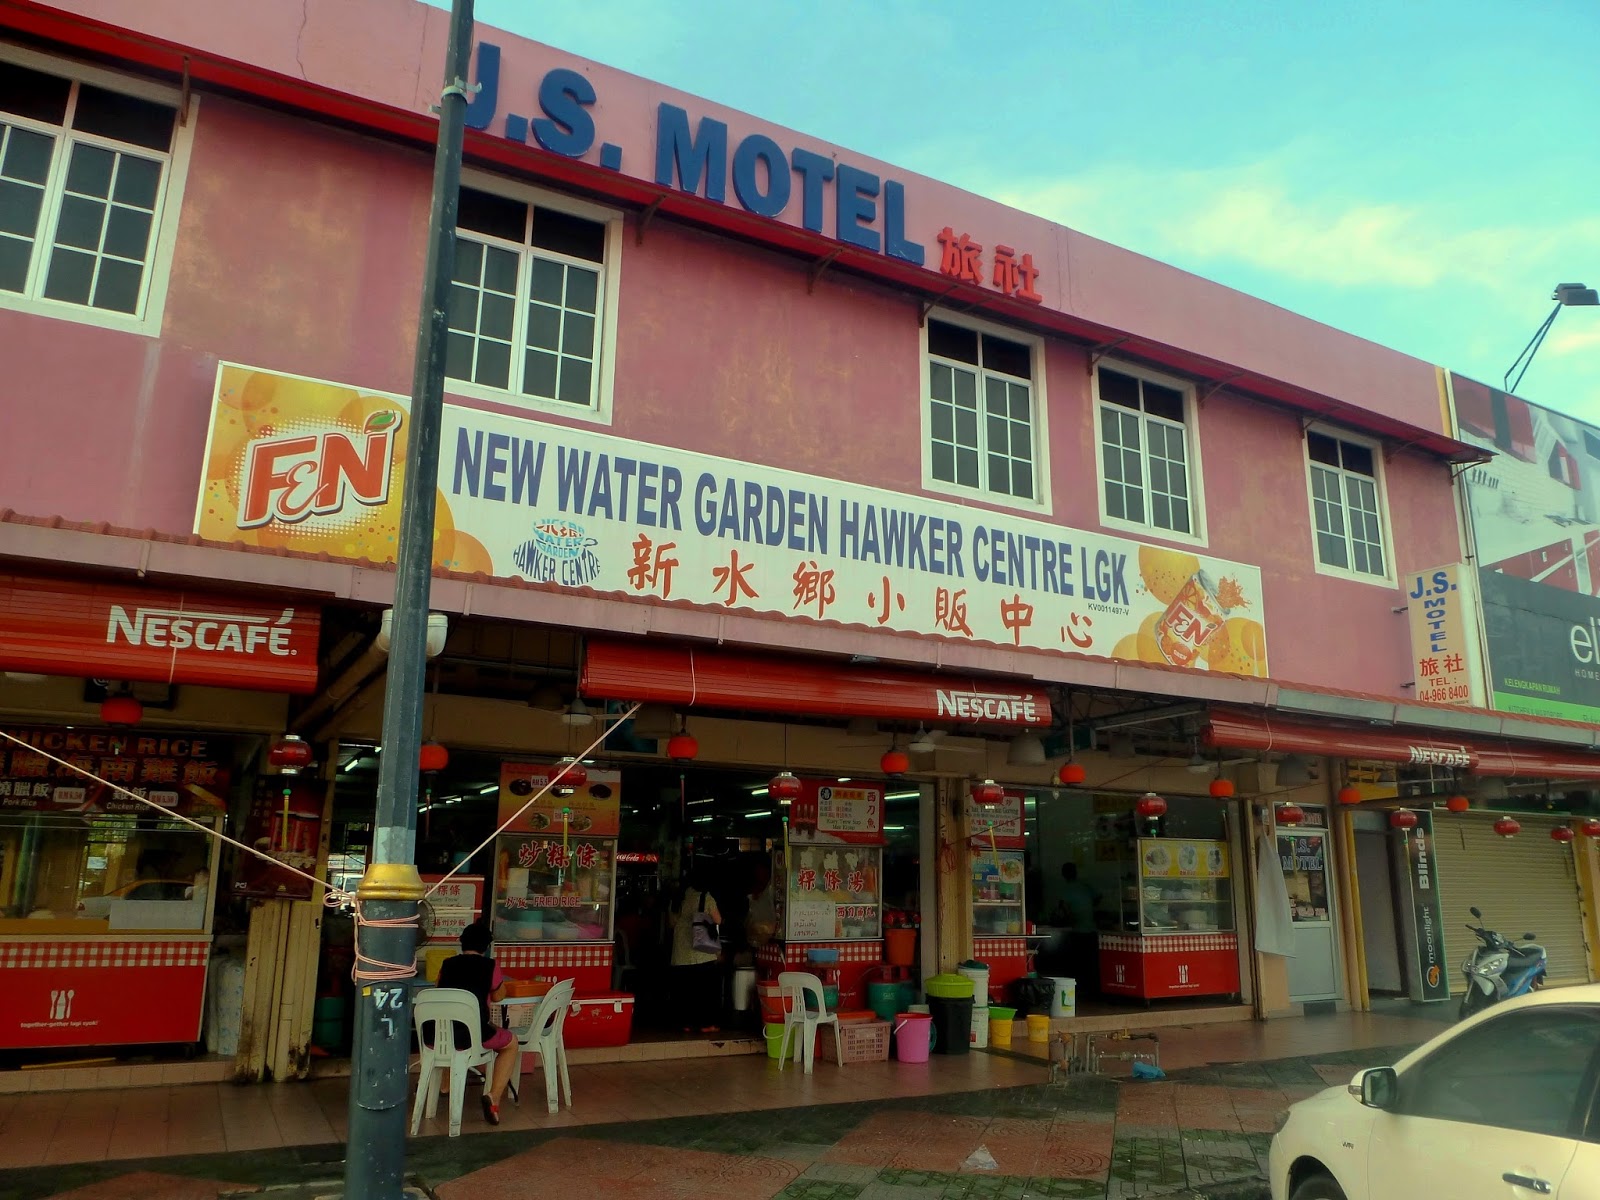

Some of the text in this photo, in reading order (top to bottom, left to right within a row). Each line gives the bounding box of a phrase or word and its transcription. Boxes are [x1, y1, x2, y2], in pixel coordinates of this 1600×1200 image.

[464, 42, 925, 266] J.S. MOTEL
[937, 226, 1042, 303] 旅社
[240, 411, 400, 526] F&N
[453, 428, 1130, 606] NEW WATER GARDEN HAWKER CENTRE LGK
[513, 539, 601, 586] HAWKER CENTRE
[1410, 571, 1457, 599] J.S.
[1424, 597, 1447, 652] MOTEL
[1419, 653, 1464, 677] 旅社
[1420, 684, 1469, 702] 04-966 8400
[0, 729, 208, 758] HICKEN RICE
[0, 750, 219, 786] 臘海南雞飯
[22, 798, 38, 808] Rice
[106, 802, 150, 811] Chicken Rice
[866, 791, 876, 829] 西刀魚
[518, 839, 598, 869] 炒粿條
[1282, 855, 1323, 871] MOTEL
[1414, 827, 1430, 890] Blinds
[797, 868, 864, 894] 粿條湯
[534, 895, 582, 908] FRIED RICE
[1421, 906, 1435, 964] moonlight
